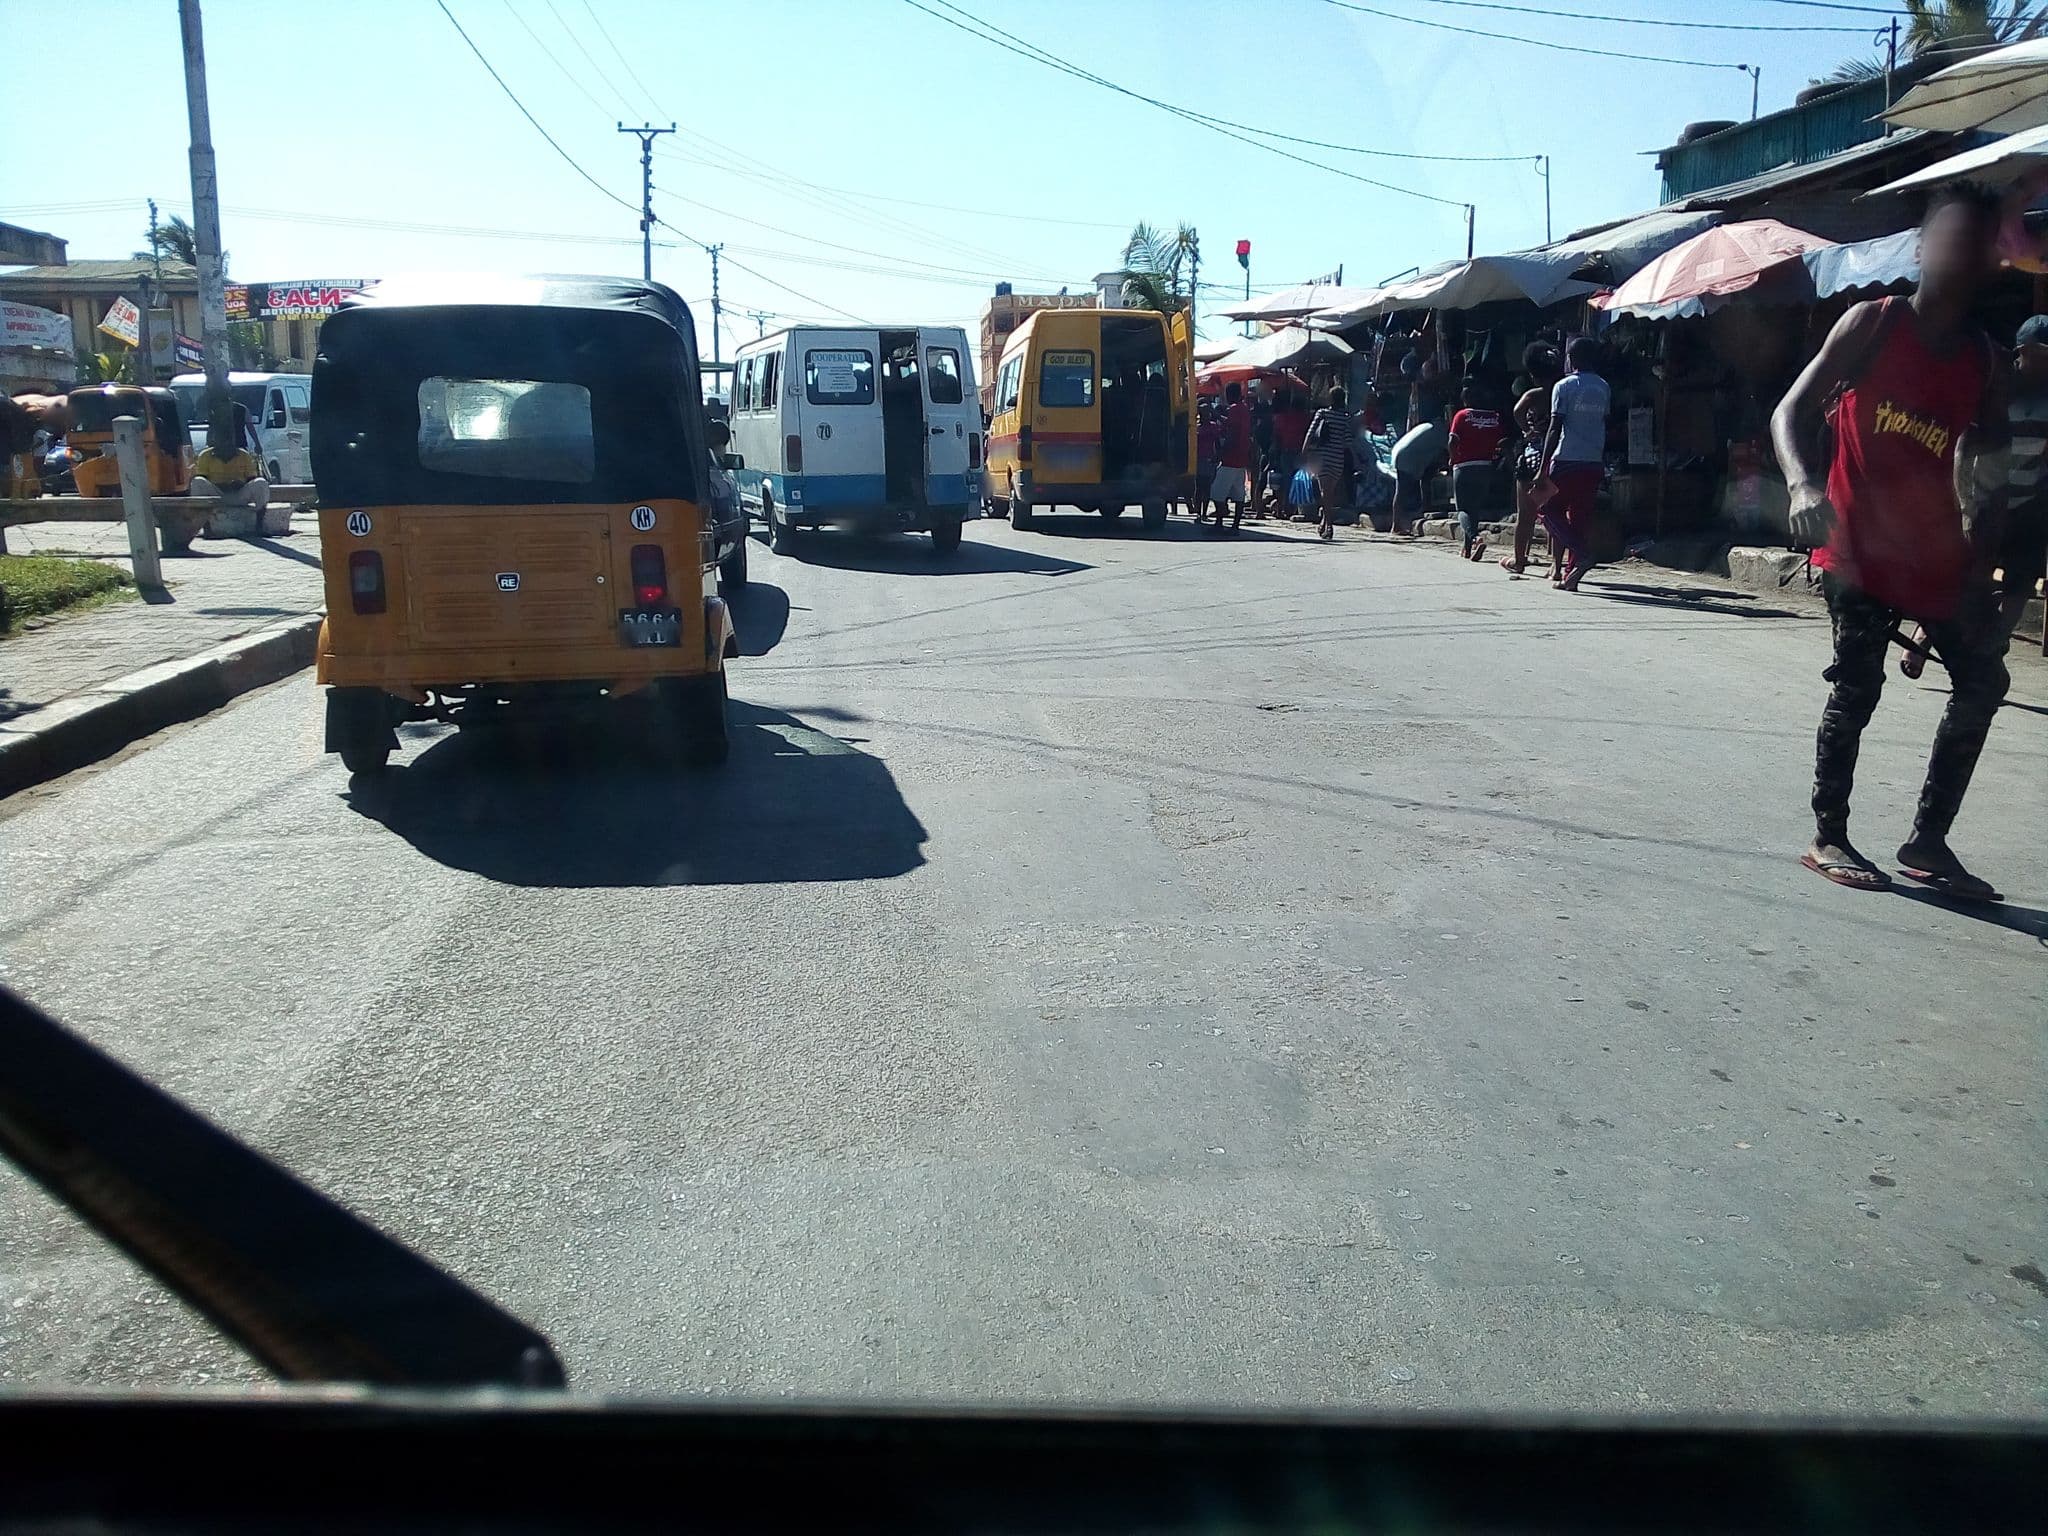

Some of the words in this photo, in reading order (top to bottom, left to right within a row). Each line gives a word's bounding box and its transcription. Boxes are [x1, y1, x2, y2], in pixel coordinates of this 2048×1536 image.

[818, 424, 831, 440] 70
[1873, 400, 1949, 458] THRASHER
[350, 513, 369, 534] 40
[636, 507, 651, 528] KH
[500, 578, 516, 588] RE
